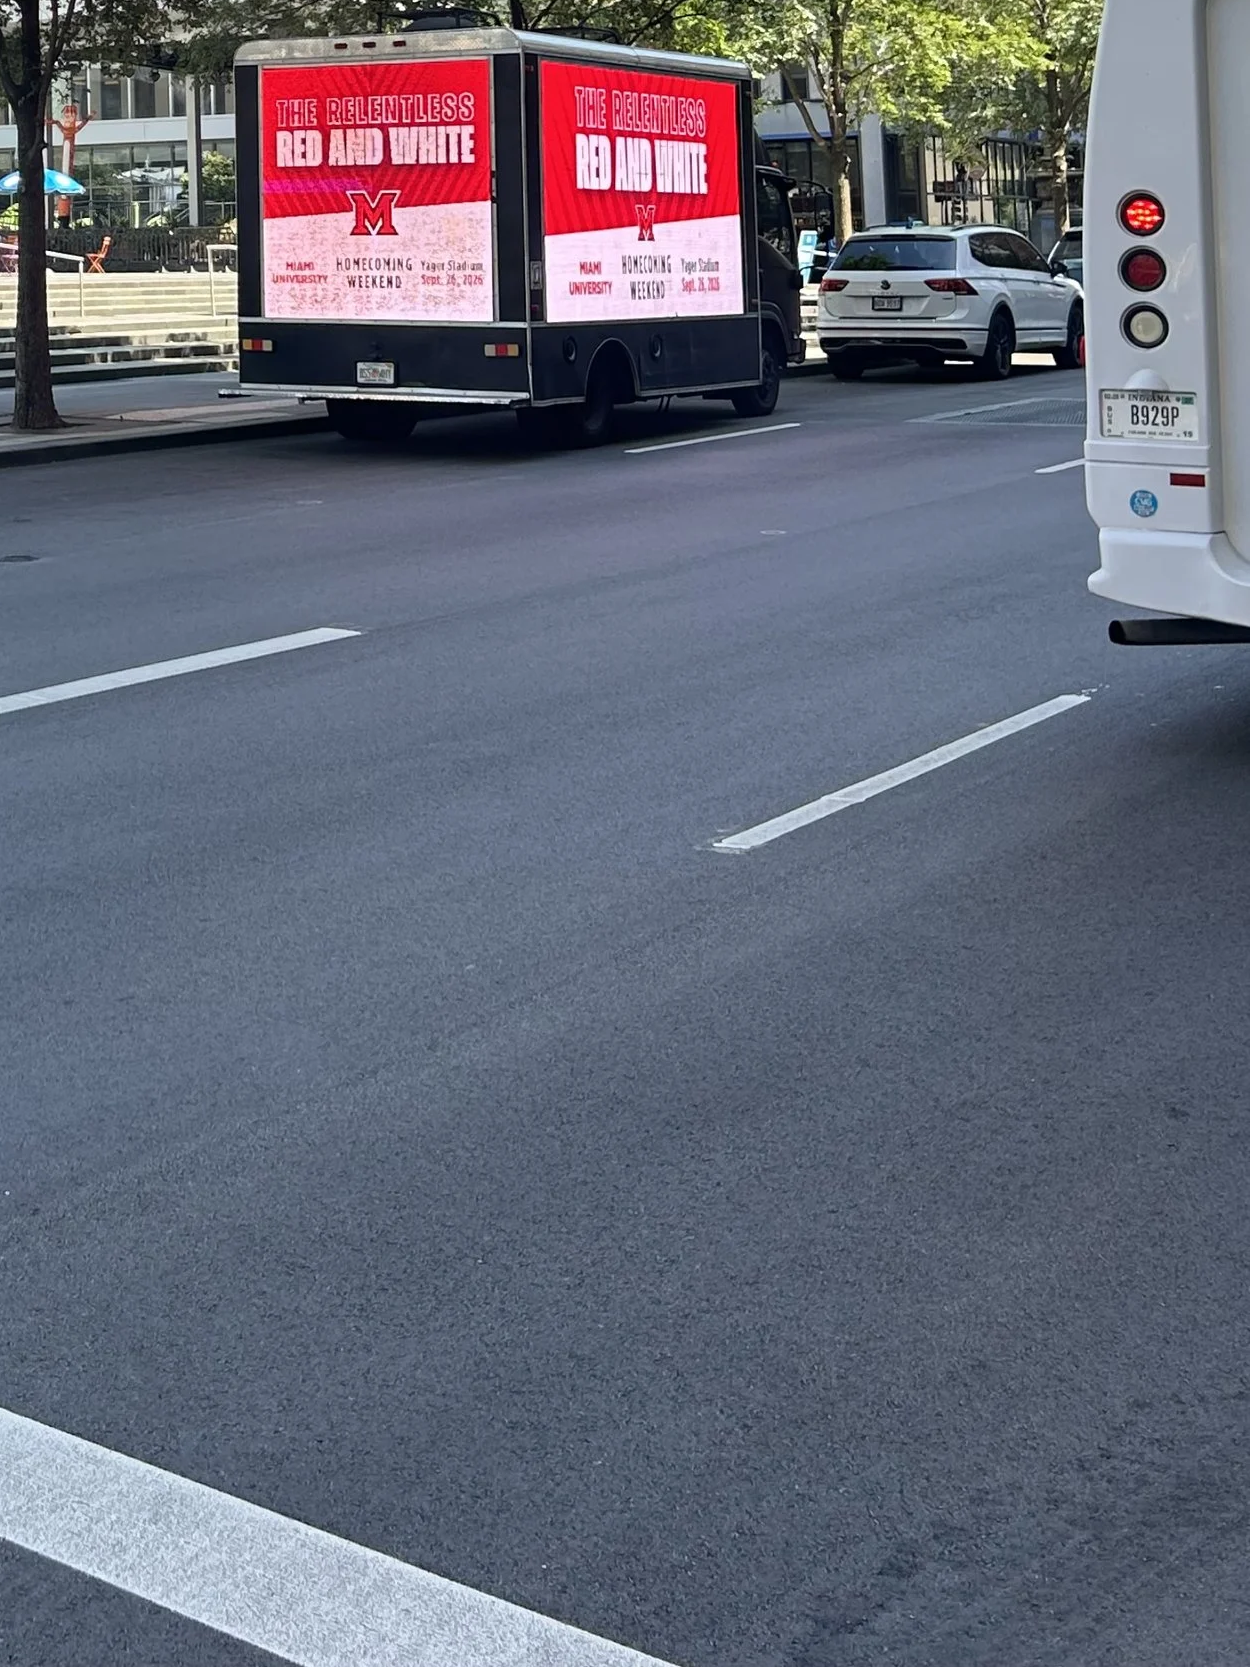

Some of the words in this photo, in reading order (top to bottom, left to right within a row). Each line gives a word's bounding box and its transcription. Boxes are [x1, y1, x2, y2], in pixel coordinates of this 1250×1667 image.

[276, 98, 317, 127] THE
[326, 92, 475, 125] RELENTLESS
[574, 86, 606, 129] THE
[612, 90, 706, 138] RELENTLESS
[276, 129, 323, 168] RED
[328, 127, 384, 167] AND
[388, 125, 476, 166] WHITE
[575, 133, 611, 191] RED
[615, 136, 653, 193] AND
[654, 139, 708, 195] WHITE
[346, 190, 401, 235] M
[635, 204, 656, 241] M
[285, 262, 315, 271] MIAMI
[336, 257, 413, 271] HOMECOMING
[579, 261, 602, 275] MIAMI
[621, 254, 672, 275] HOMECOMING
[272, 274, 328, 284] UNIVERSITY
[347, 275, 403, 289] WEEKEND
[569, 281, 613, 295] UNIVERSITY
[630, 281, 666, 300] WEEKEND
[1128, 394, 1171, 403] INDIANA
[1131, 404, 1179, 427] B929P
